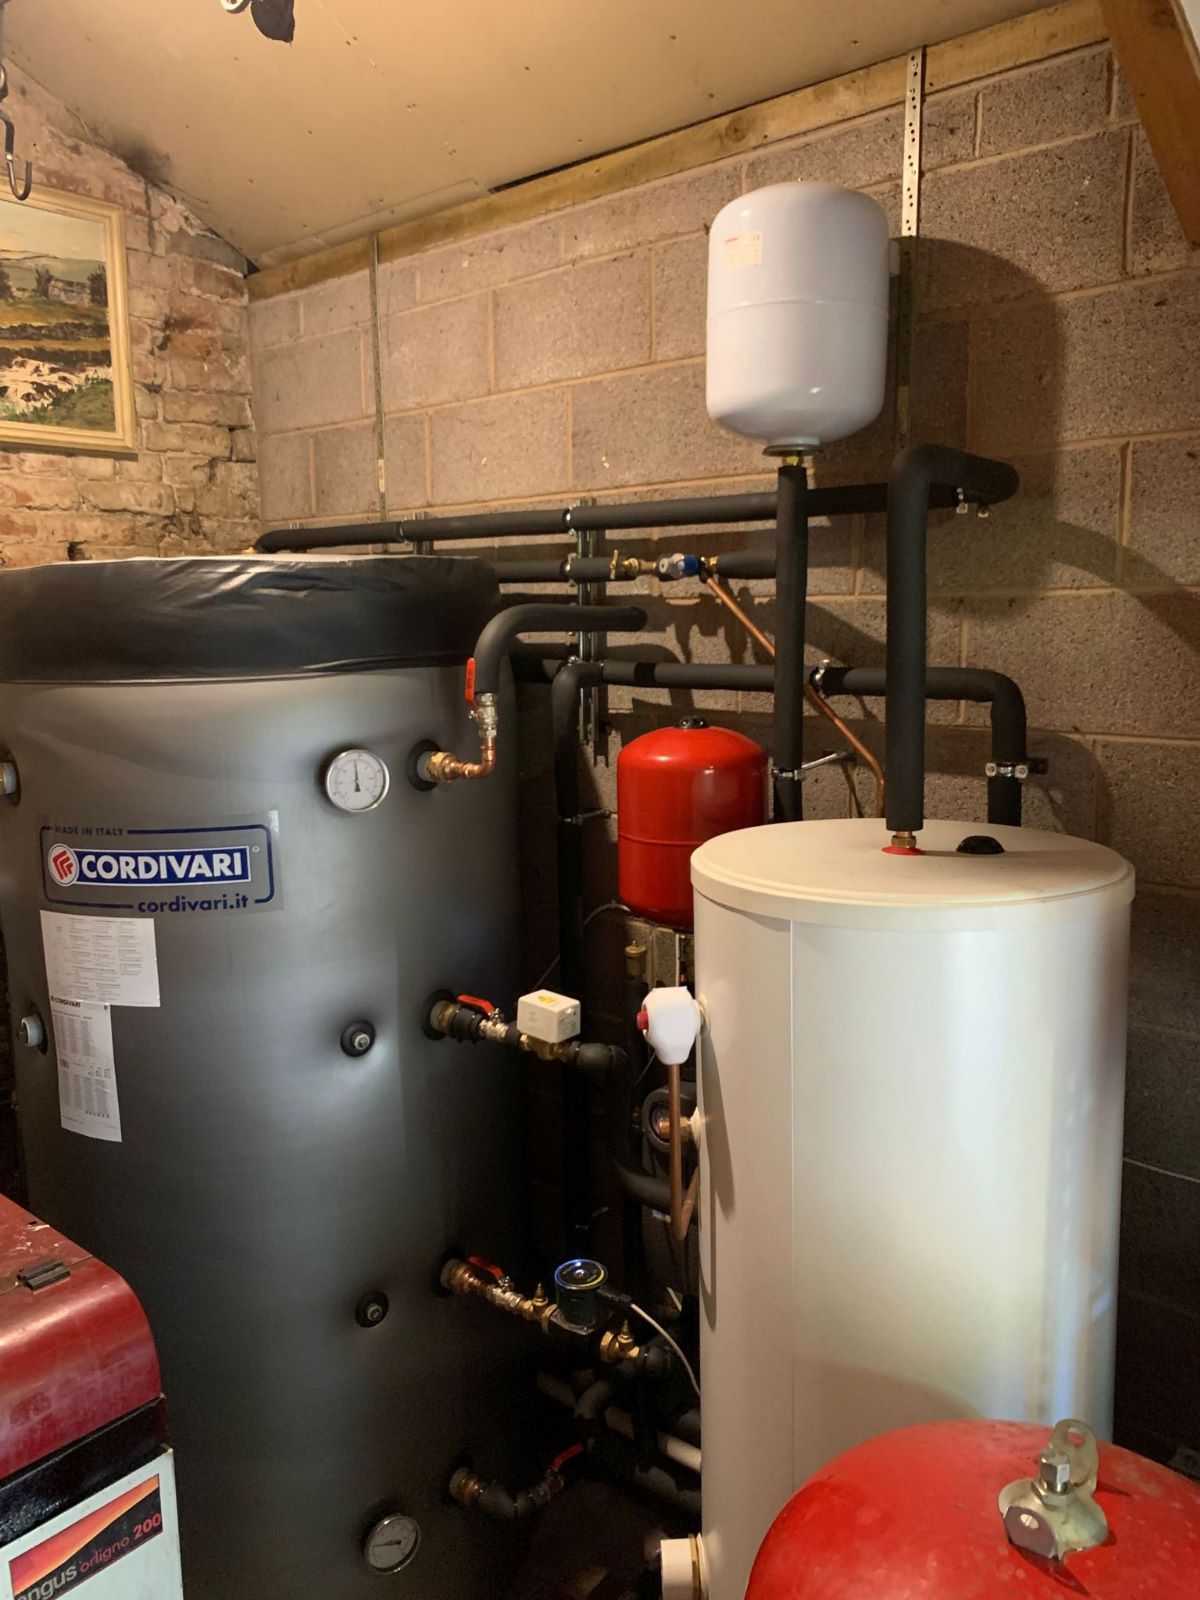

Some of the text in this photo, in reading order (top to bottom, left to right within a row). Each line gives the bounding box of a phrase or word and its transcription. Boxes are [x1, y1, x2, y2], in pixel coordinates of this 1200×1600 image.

[54, 826, 124, 836] MADE IN ITALY
[81, 852, 242, 879] CORDIVARI
[138, 893, 249, 912] cordivari.it
[133, 1513, 161, 1540] 200
